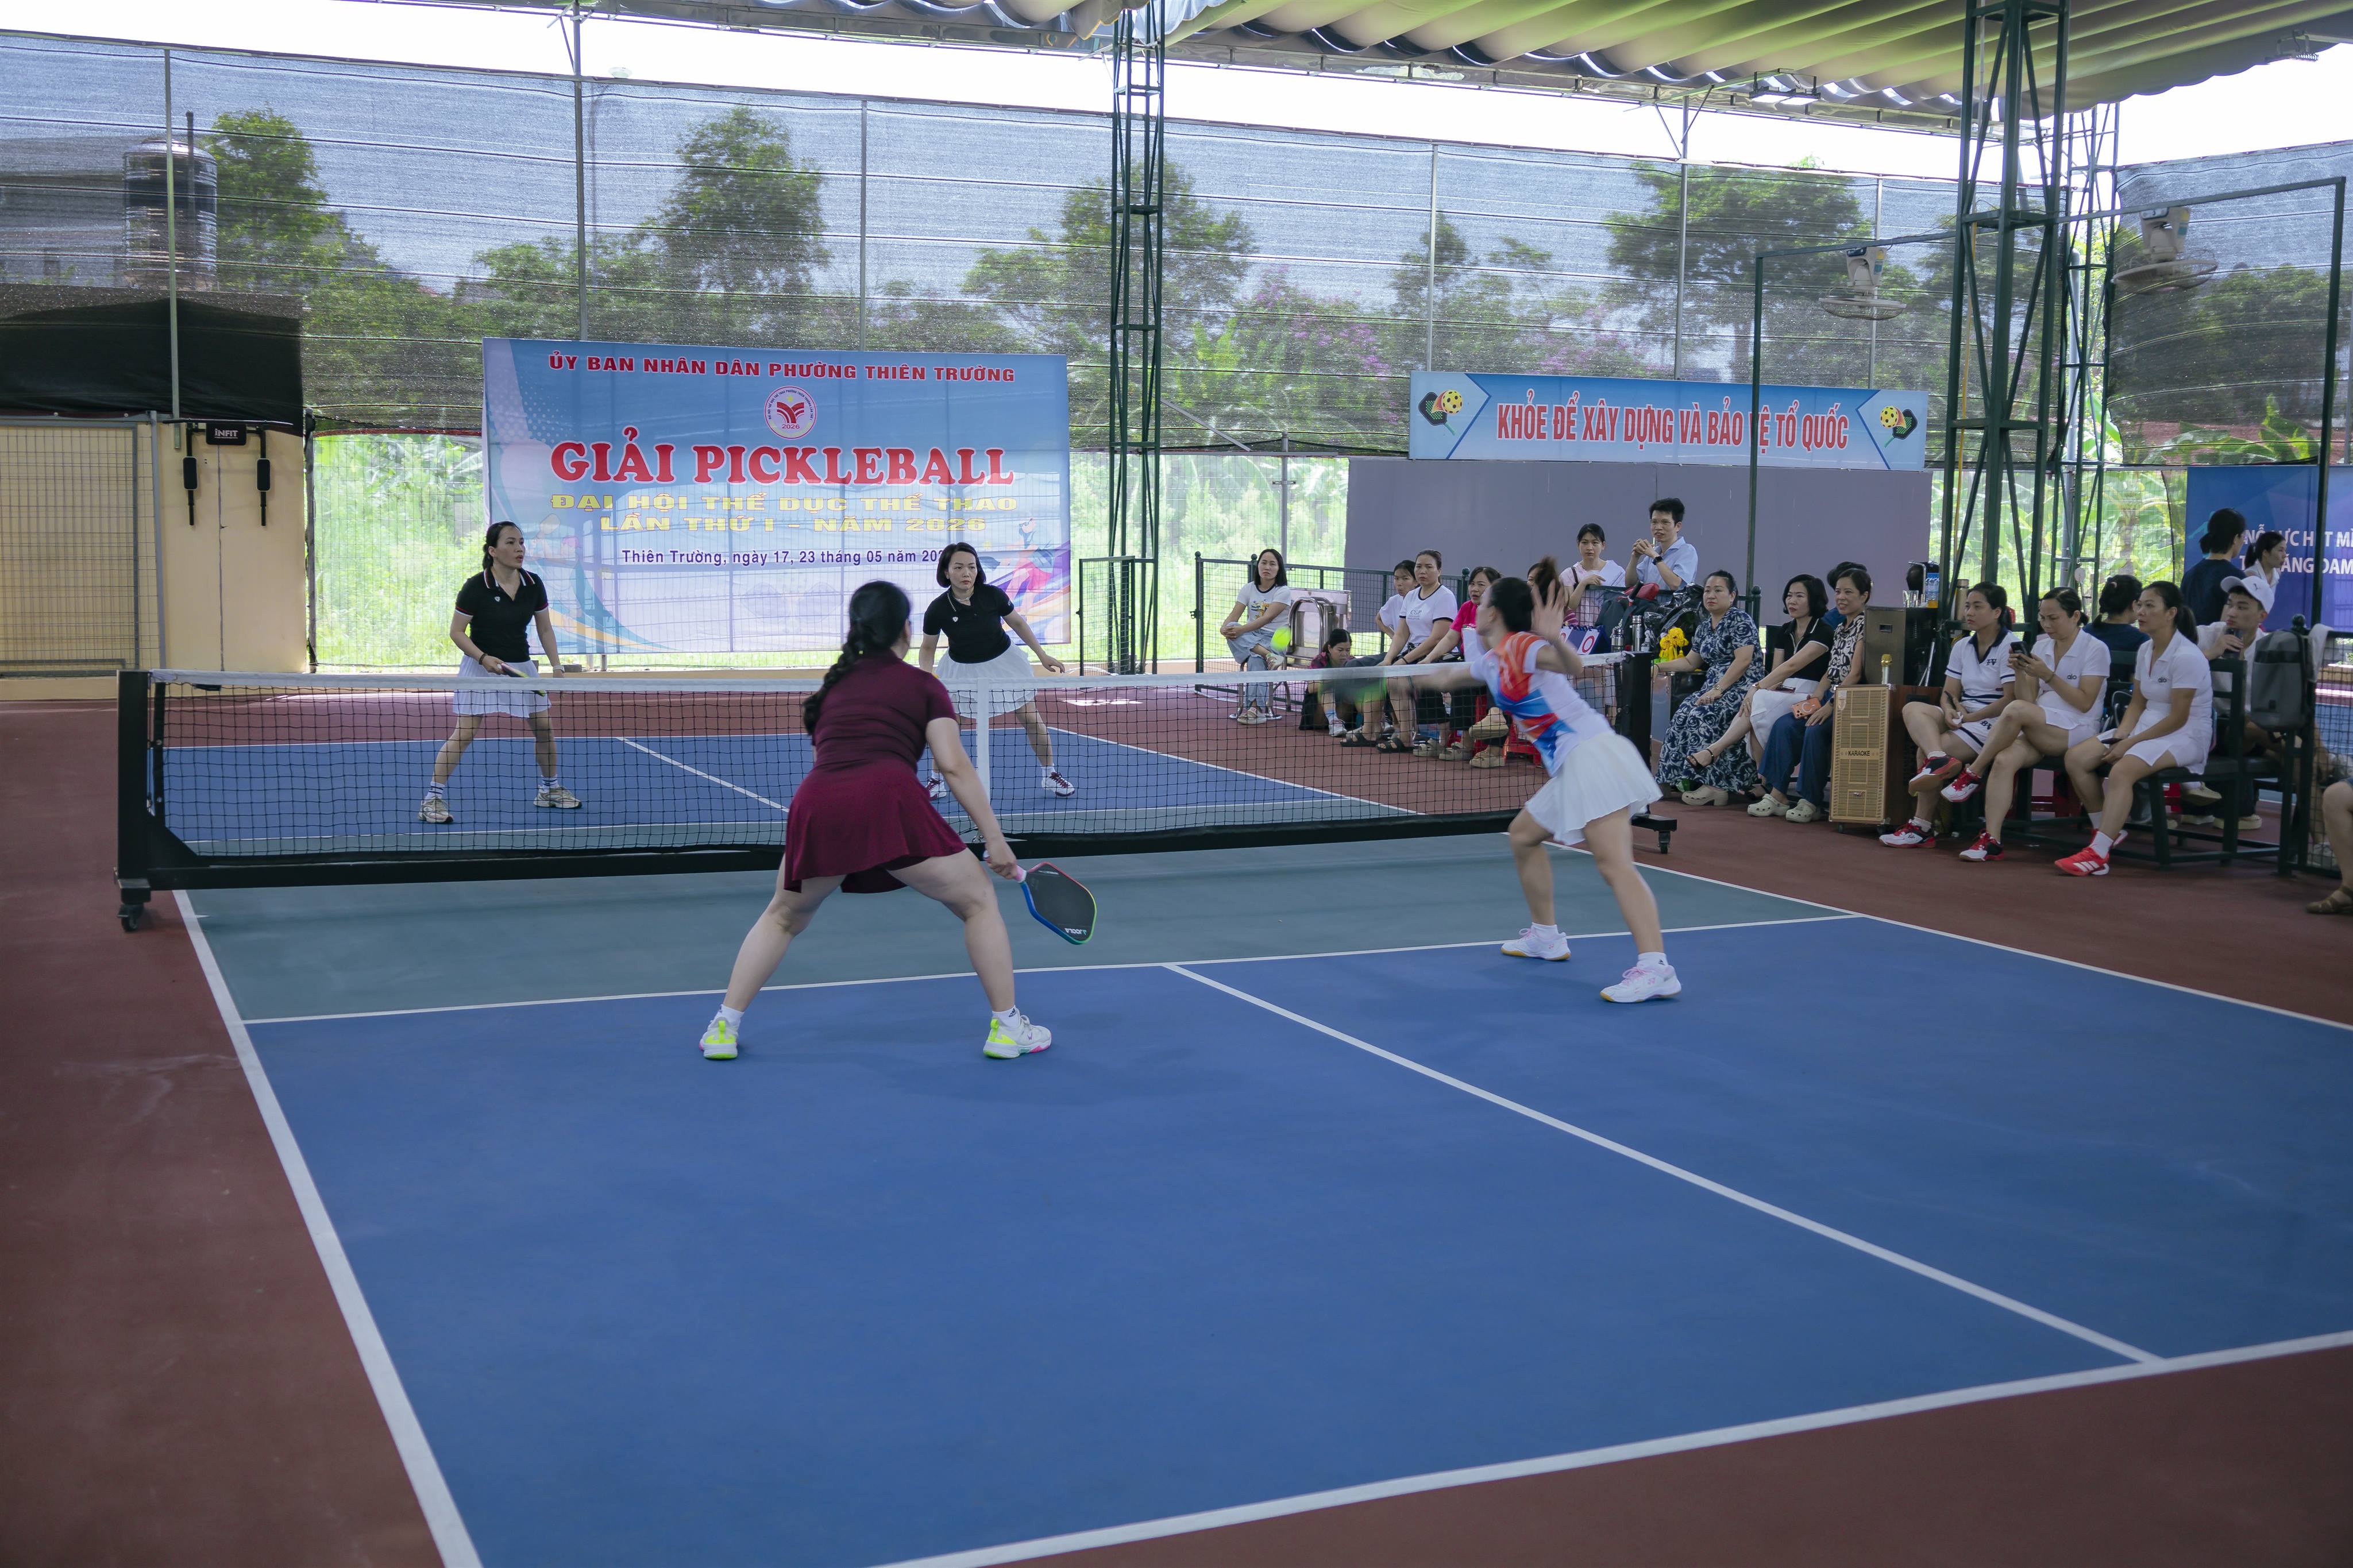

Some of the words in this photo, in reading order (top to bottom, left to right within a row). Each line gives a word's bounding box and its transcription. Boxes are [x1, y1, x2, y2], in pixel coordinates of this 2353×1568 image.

[549, 351, 577, 370] ỦY
[587, 356, 633, 372] BAN
[643, 357, 705, 374] NHÂN
[715, 359, 759, 376] DÂN
[769, 361, 856, 379] PHƯỜNG
[865, 364, 925, 380] THIÊN
[934, 365, 1015, 382] TRƯỜNG
[1497, 388, 1547, 441] KHỎE
[1553, 391, 1580, 441] ĐỂ
[1582, 399, 1619, 442] XÂY
[1624, 404, 1673, 450] DỰNG
[1679, 403, 1703, 445] VÀ
[1707, 396, 1742, 446] BẢO
[1776, 400, 1799, 448] TỔ
[1802, 403, 1849, 453] QUỐC
[550, 426, 676, 483] GIẢI
[692, 445, 1014, 485] PICKLEBALL
[550, 494, 614, 512] ĐẠI
[628, 493, 688, 512] HỘI
[701, 492, 767, 511] THỂ
[779, 497, 848, 513] DỤC
[860, 492, 923, 511] THỂ
[932, 497, 1017, 511] THAO
[600, 512, 671, 530] LẦN
[684, 515, 754, 531] THỨ
[764, 517, 773, 531] I
[813, 515, 893, 532] NĂM
[905, 518, 986, 532] 2026
[2303, 531, 2333, 547] HT
[622, 550, 664, 563] Thiên
[670, 550, 727, 566] Trường,
[732, 550, 767, 566] ngày
[774, 550, 794, 566] 17,
[799, 551, 815, 563] 23
[821, 550, 861, 565] tháng
[866, 550, 882, 563] 05
[888, 550, 916, 562] năm
